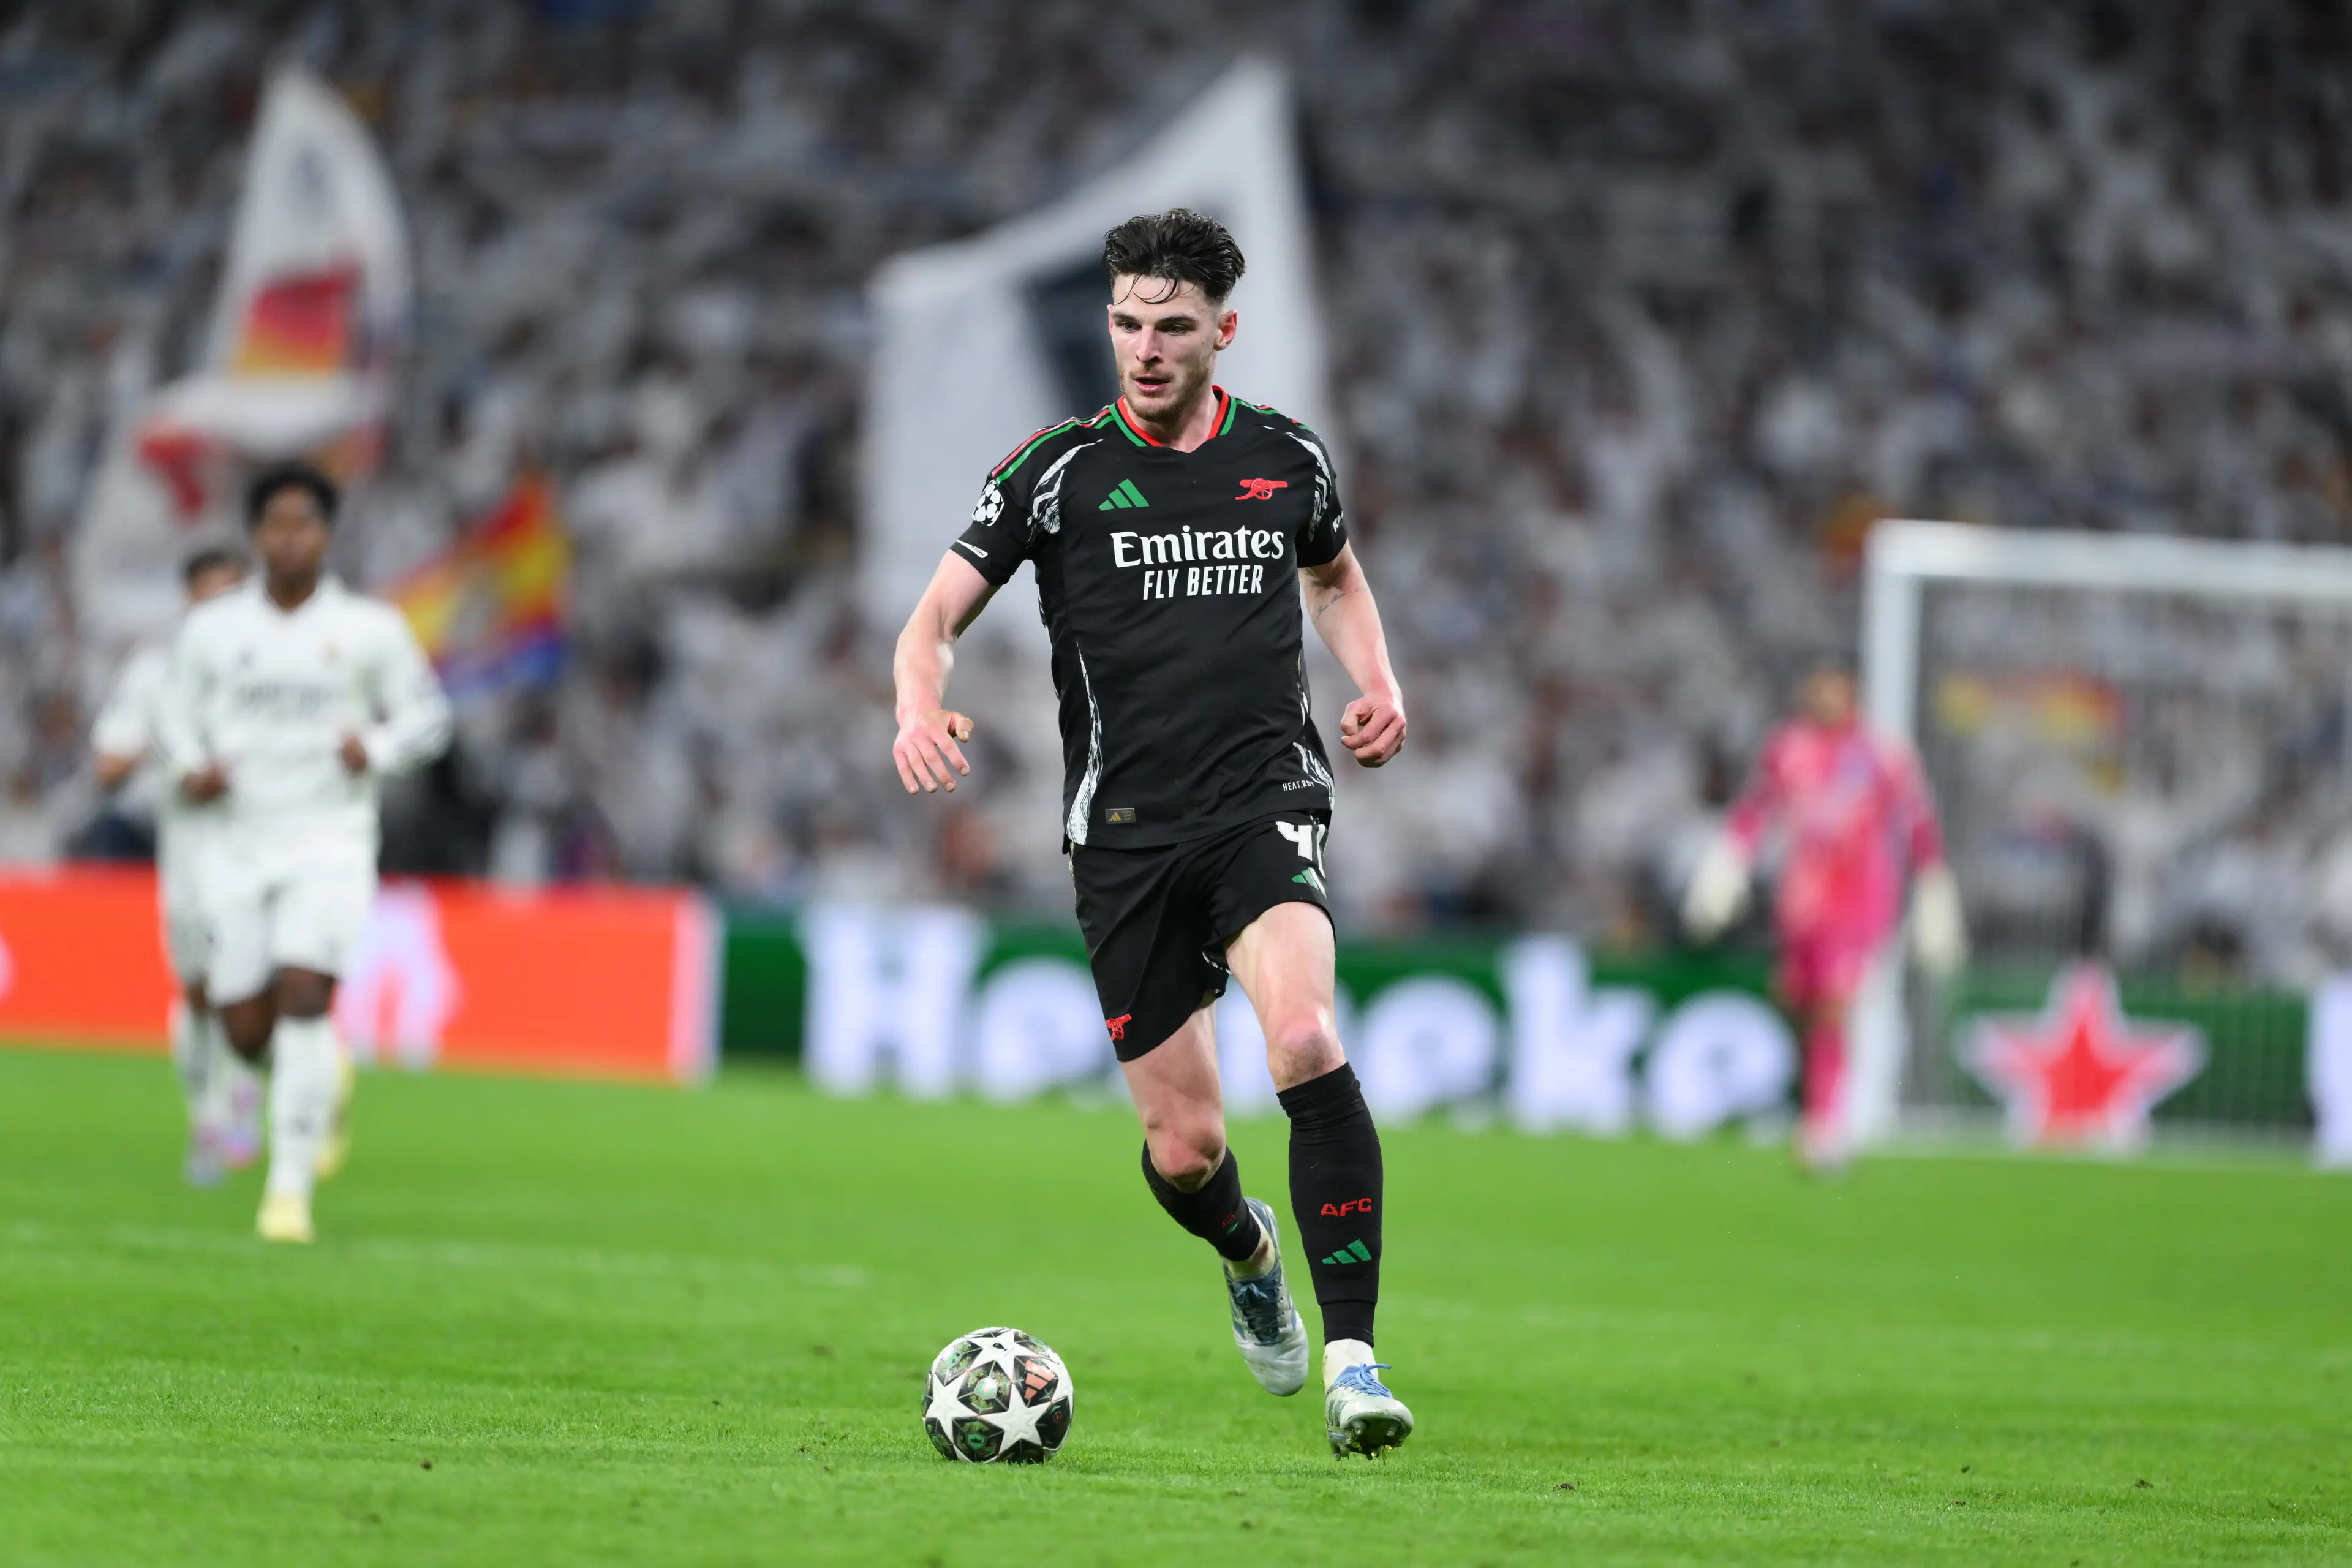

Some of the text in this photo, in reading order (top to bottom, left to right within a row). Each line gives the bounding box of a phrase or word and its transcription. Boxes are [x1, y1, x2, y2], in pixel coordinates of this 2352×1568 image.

[1110, 525, 1284, 568] Emirates
[1143, 565, 1264, 600] FLY BETTER
[1321, 1197, 1372, 1216] AFC
